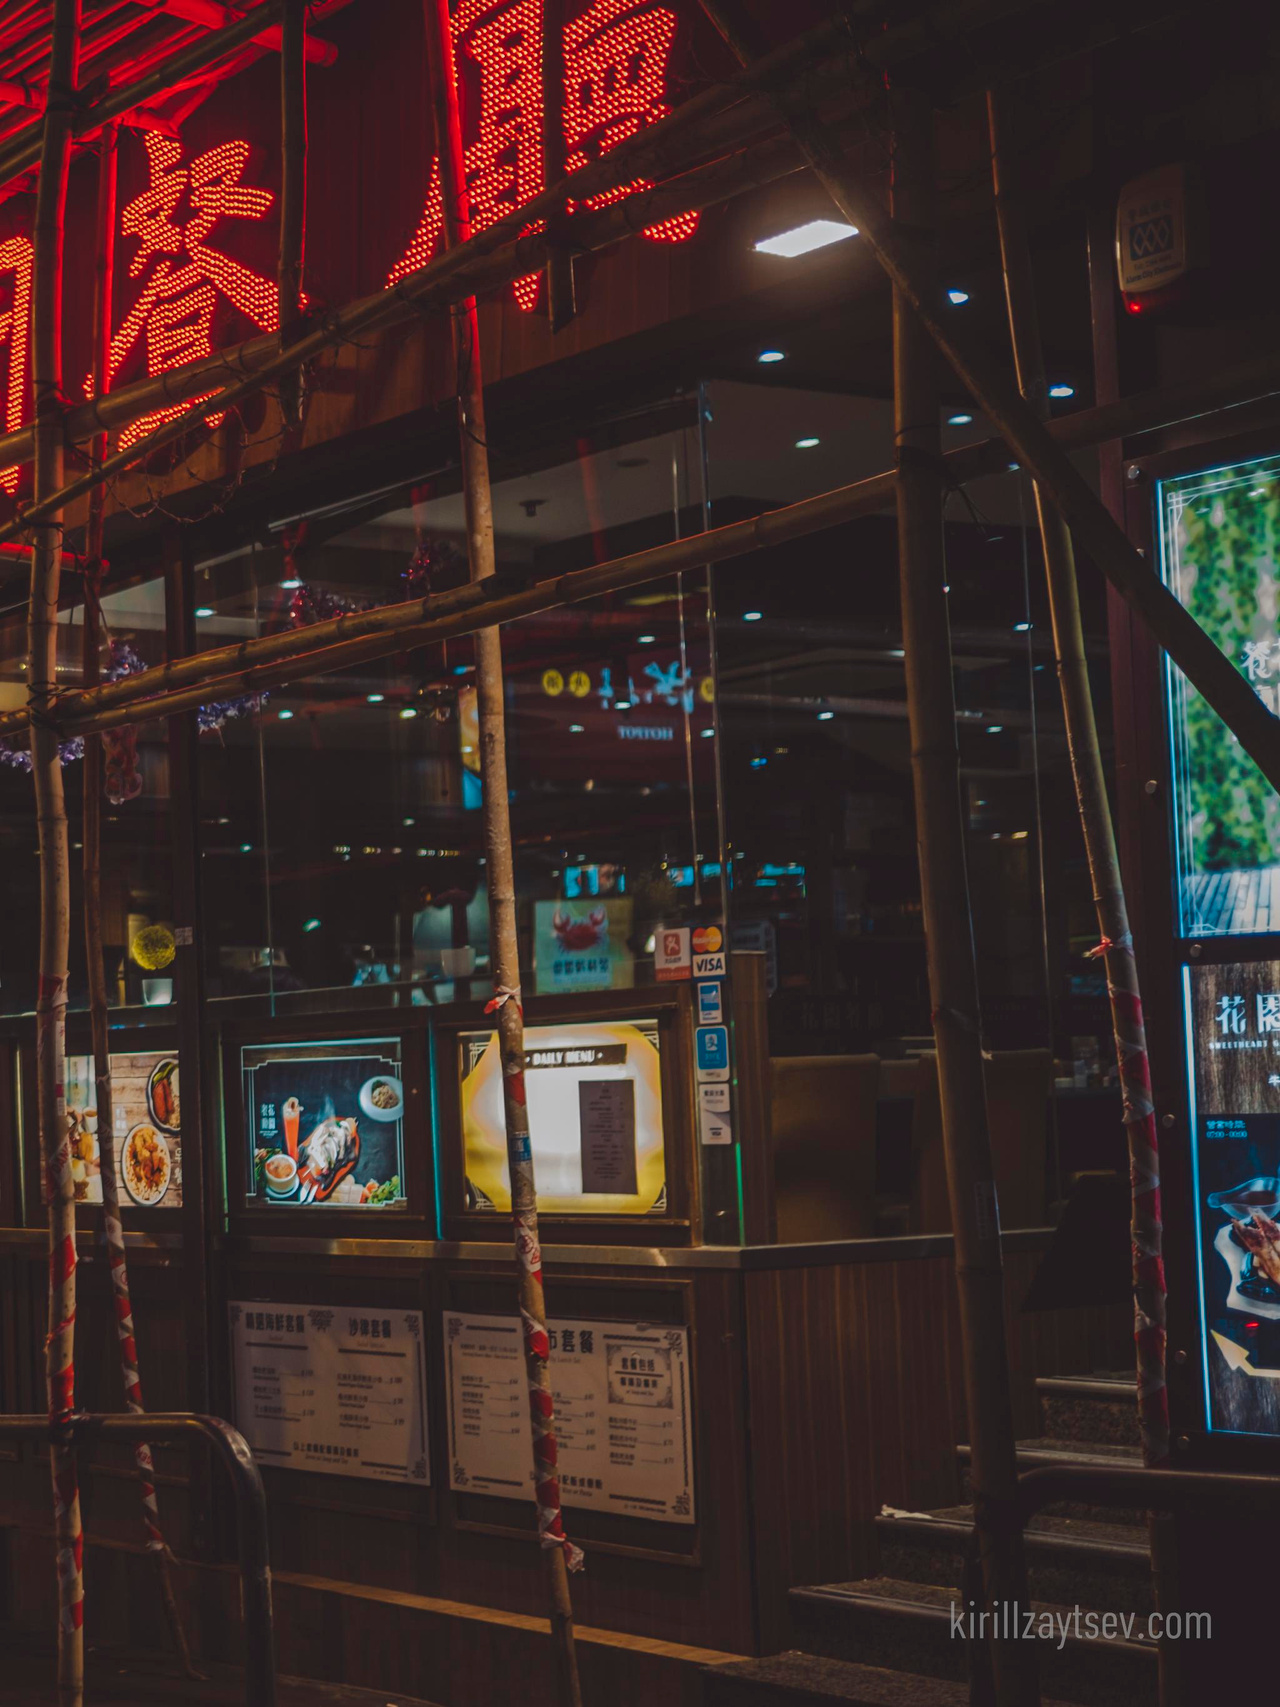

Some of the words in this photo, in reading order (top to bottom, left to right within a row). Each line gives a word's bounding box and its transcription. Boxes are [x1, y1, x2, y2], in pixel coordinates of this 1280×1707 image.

[696, 957, 723, 973] VISA
[532, 1051, 563, 1066] DAILY
[564, 1050, 595, 1064] MENU
